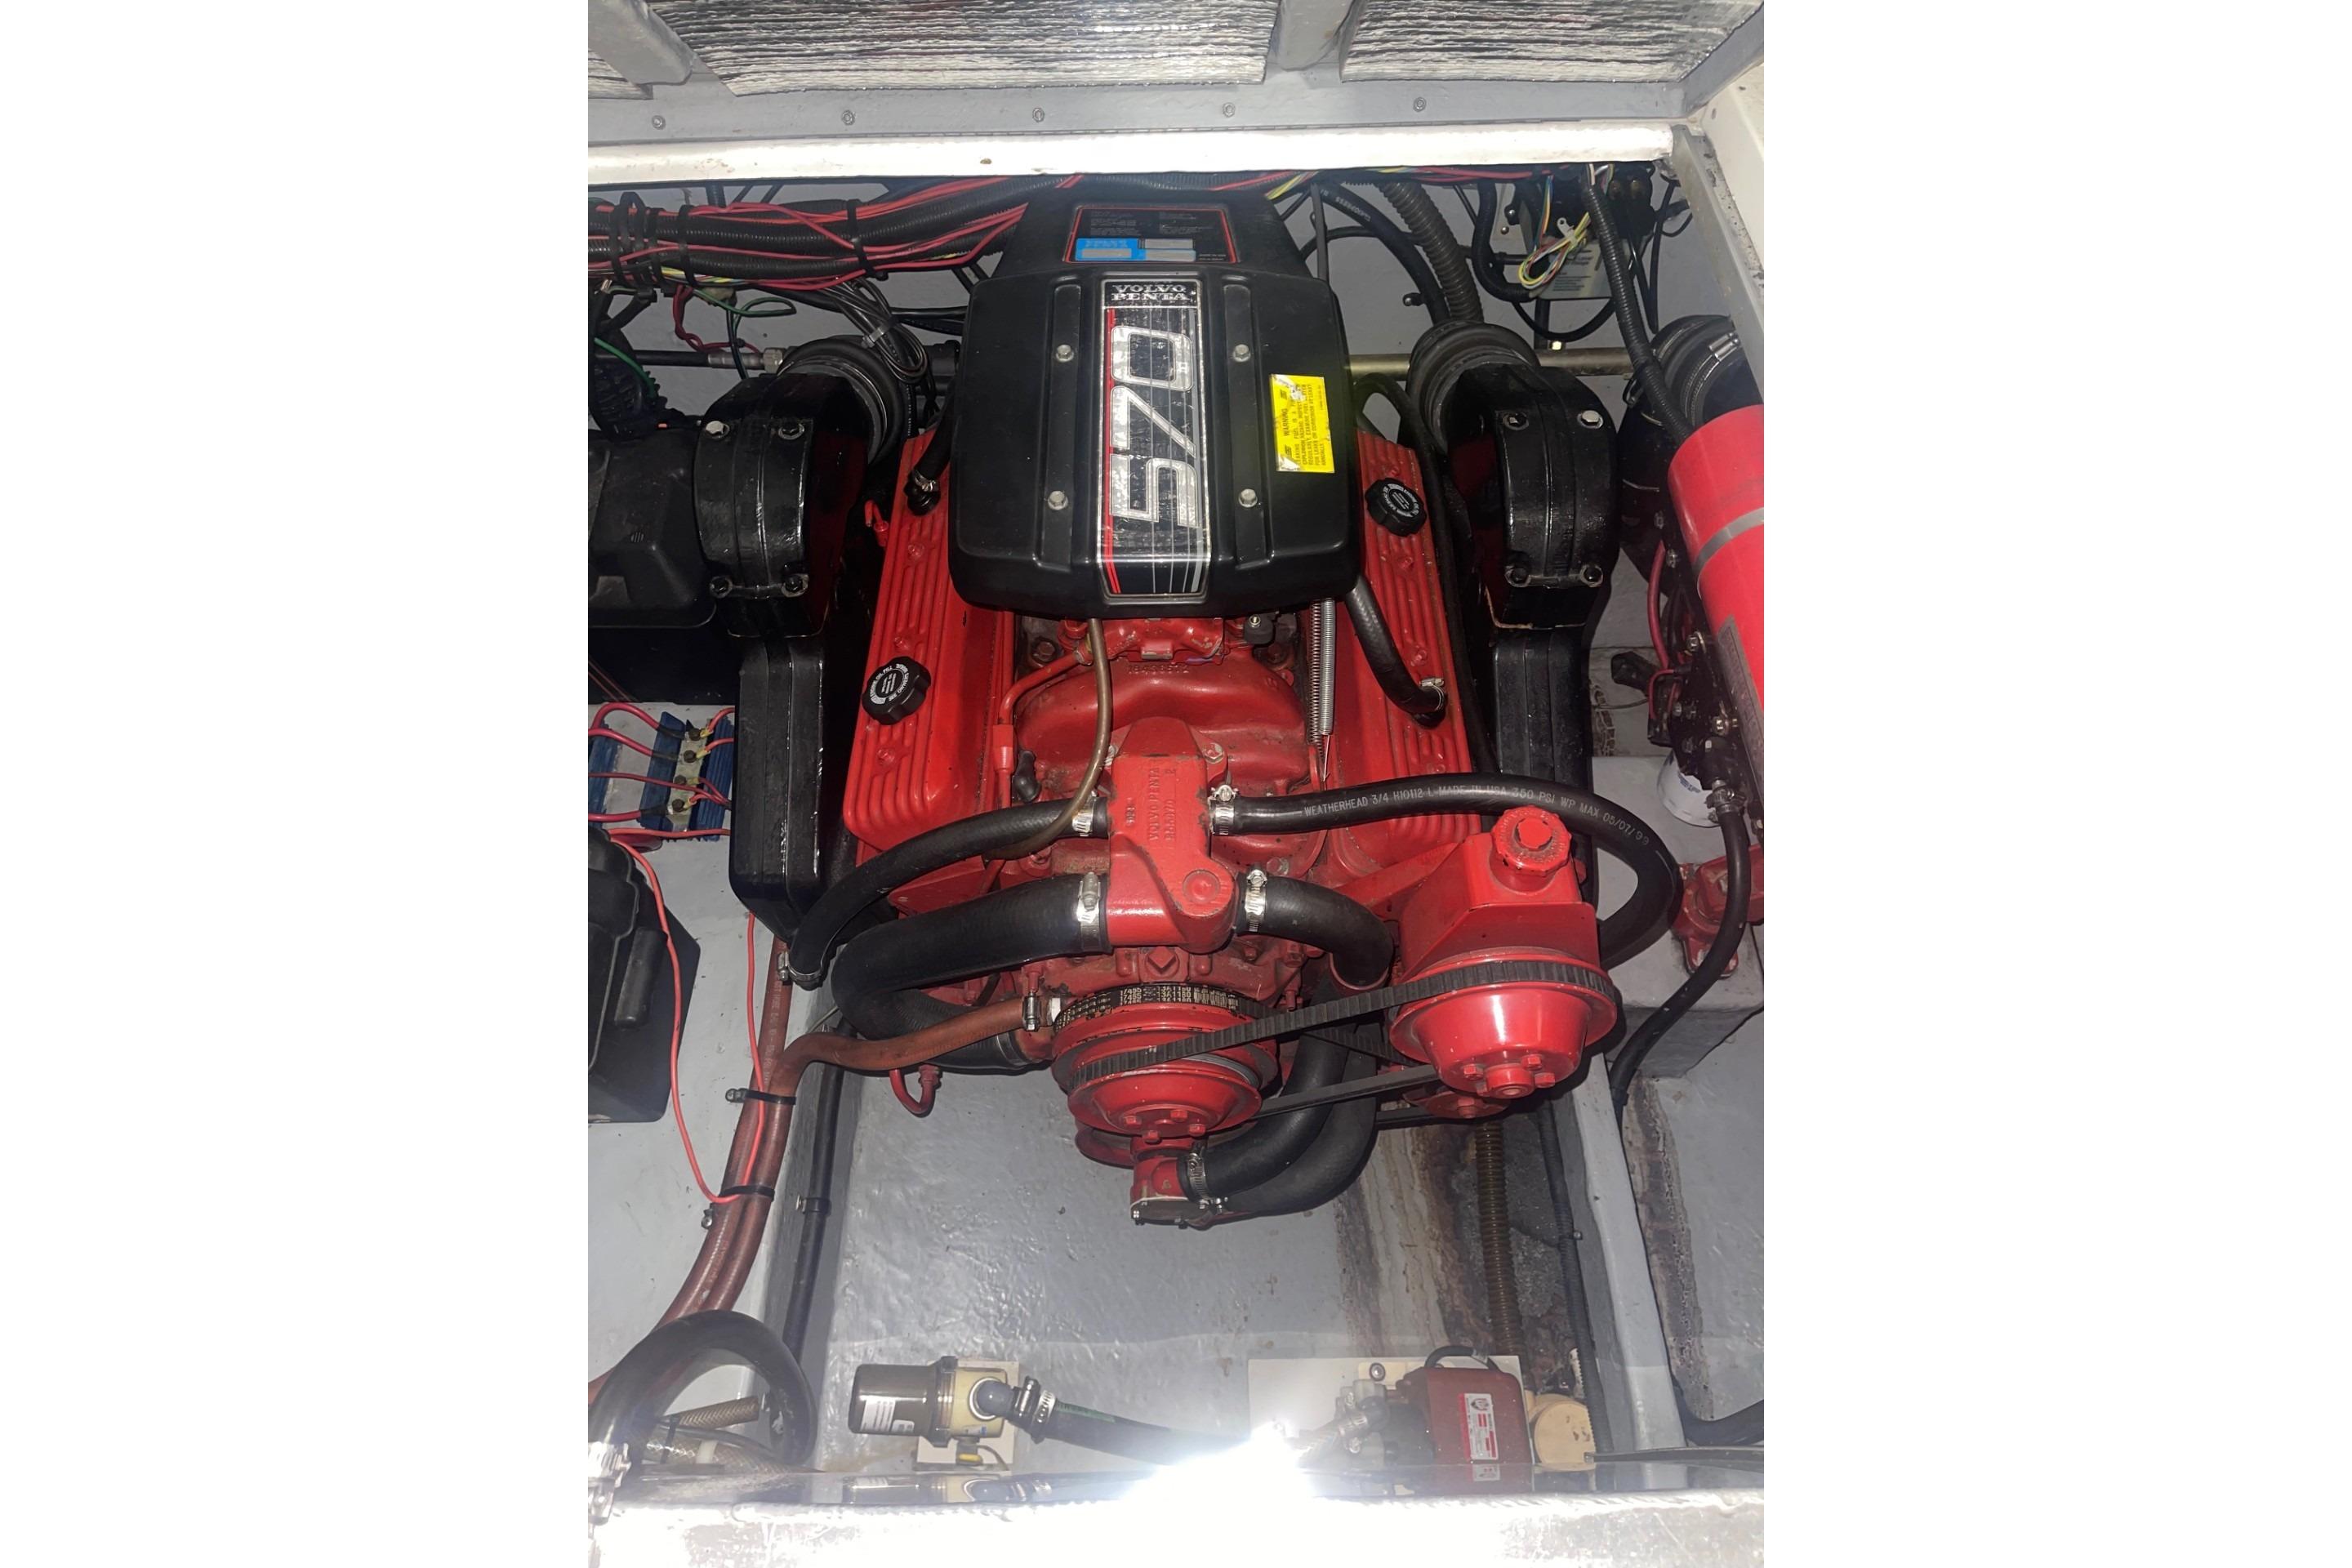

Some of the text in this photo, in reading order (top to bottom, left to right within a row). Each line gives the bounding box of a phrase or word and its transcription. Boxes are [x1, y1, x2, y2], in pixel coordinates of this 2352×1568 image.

[1111, 284, 1187, 292] VOLVO
[1111, 292, 1190, 301] PENTA
[1110, 326, 1200, 528] 570
[1304, 796, 1369, 817] WEATHERHEAD
[1371, 795, 1389, 805] 3/4
[1438, 785, 1466, 795] MADE
[1538, 792, 1555, 804] PSI
[1561, 797, 1576, 809] WP
[1579, 802, 1601, 817] MAX
